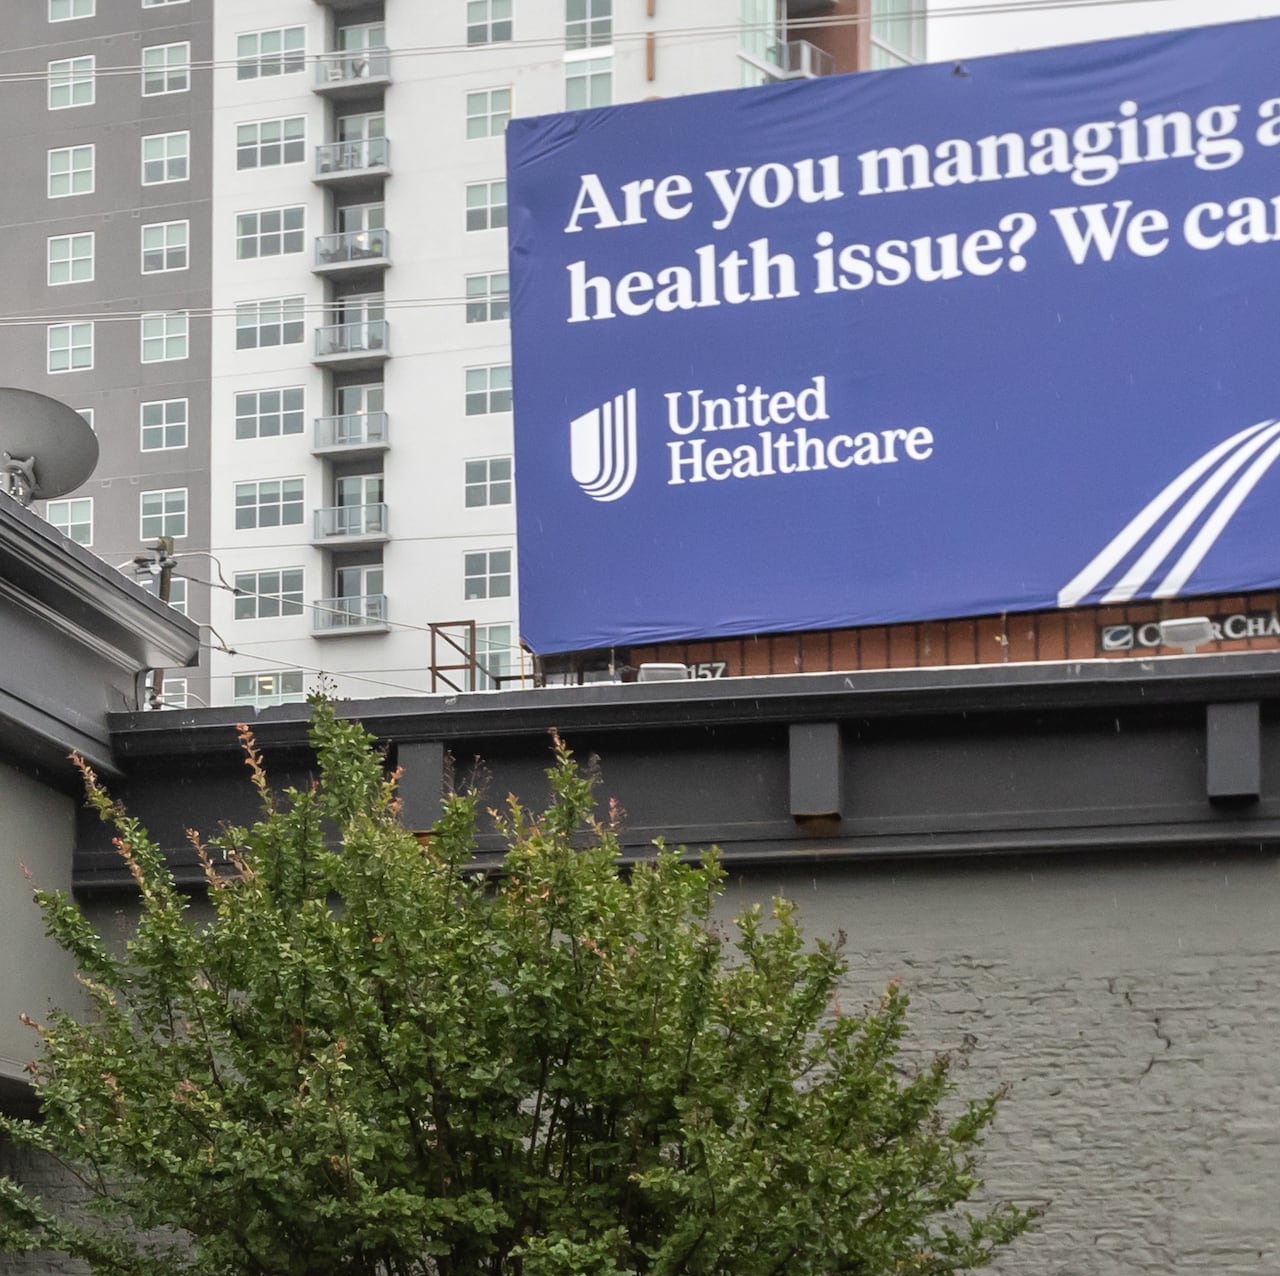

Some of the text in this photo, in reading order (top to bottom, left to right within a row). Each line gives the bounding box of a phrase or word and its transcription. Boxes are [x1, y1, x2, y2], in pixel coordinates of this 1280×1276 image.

[564, 173, 693, 233] Are
[705, 155, 844, 230] you
[857, 100, 1244, 196] managing
[566, 237, 800, 323] health
[813, 211, 1038, 294] issue?
[1049, 199, 1169, 265] We
[664, 375, 830, 435] United
[666, 425, 934, 485] Healthcare
